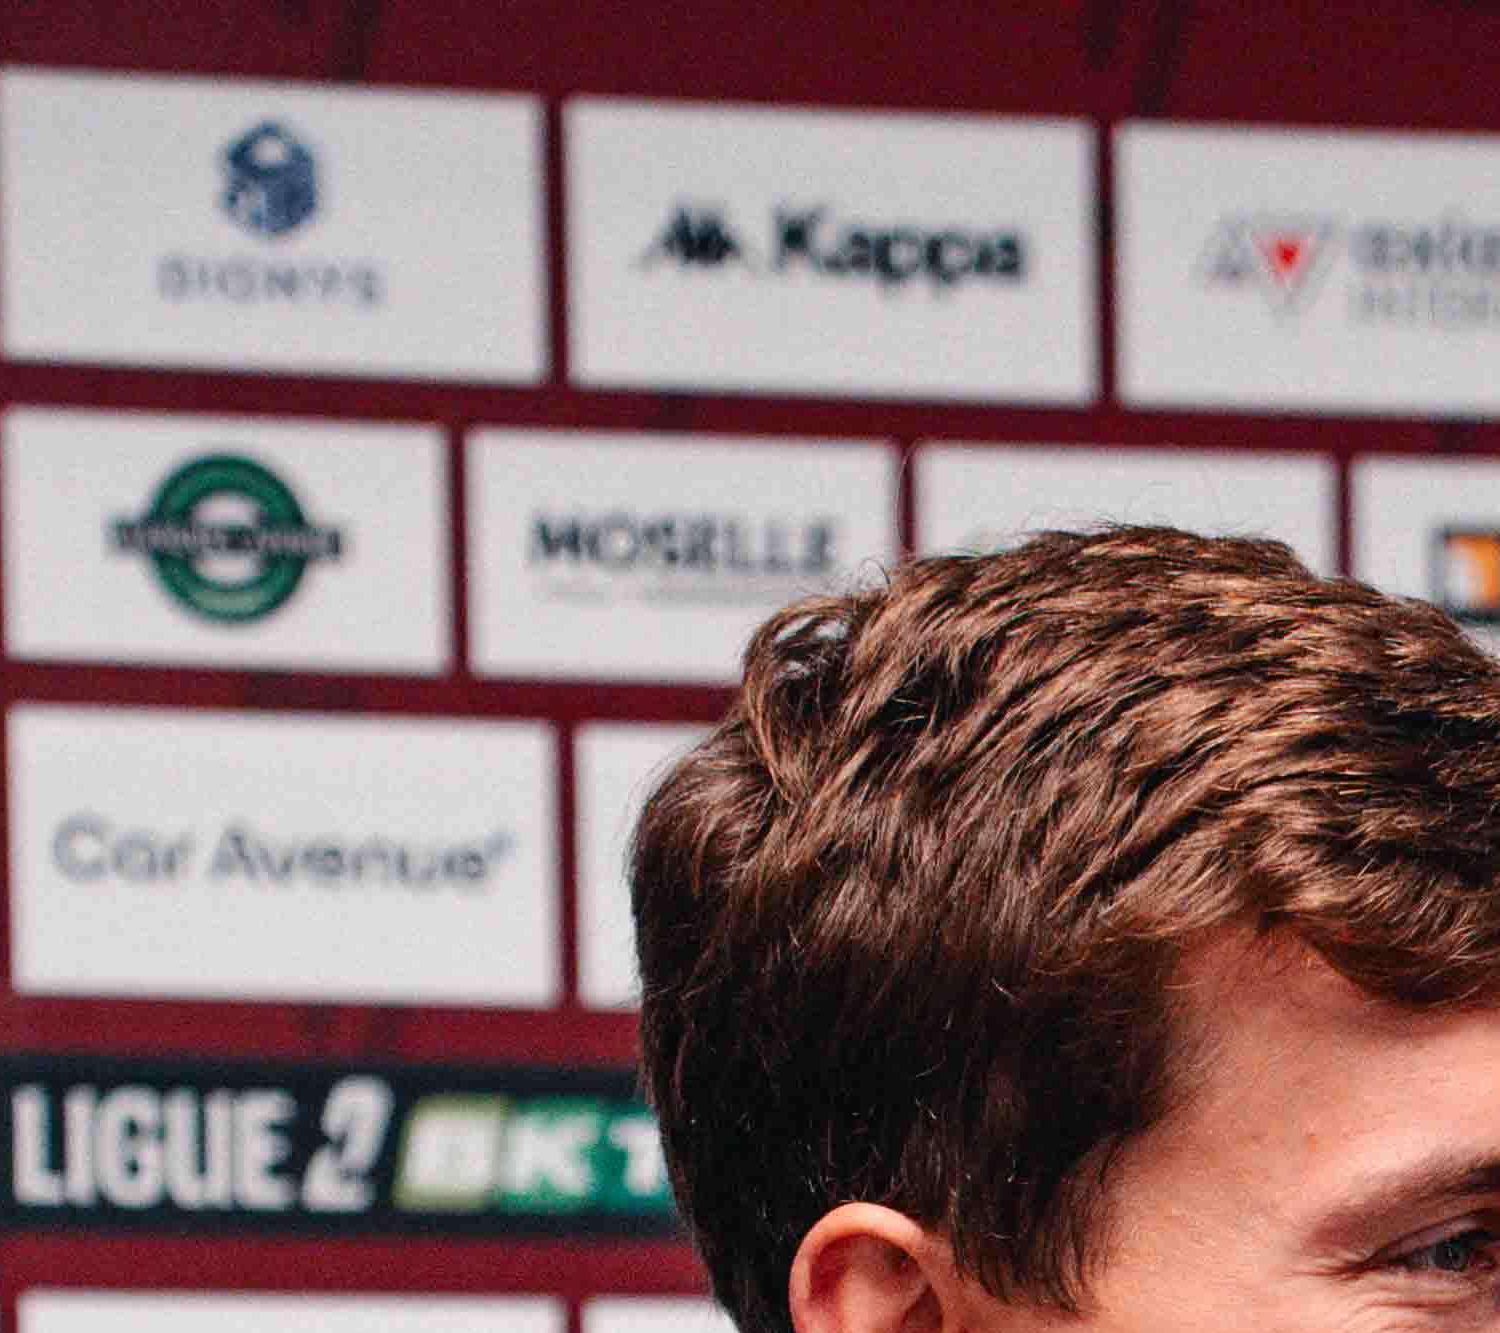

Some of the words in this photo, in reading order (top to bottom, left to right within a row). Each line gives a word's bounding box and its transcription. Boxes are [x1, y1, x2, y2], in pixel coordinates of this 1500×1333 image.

[774, 210, 1027, 289] Kappa
[533, 517, 833, 580] MOSELLE
[50, 814, 194, 883] Car
[14, 1089, 291, 1207] LIGUE
[302, 1080, 388, 1209] 2
